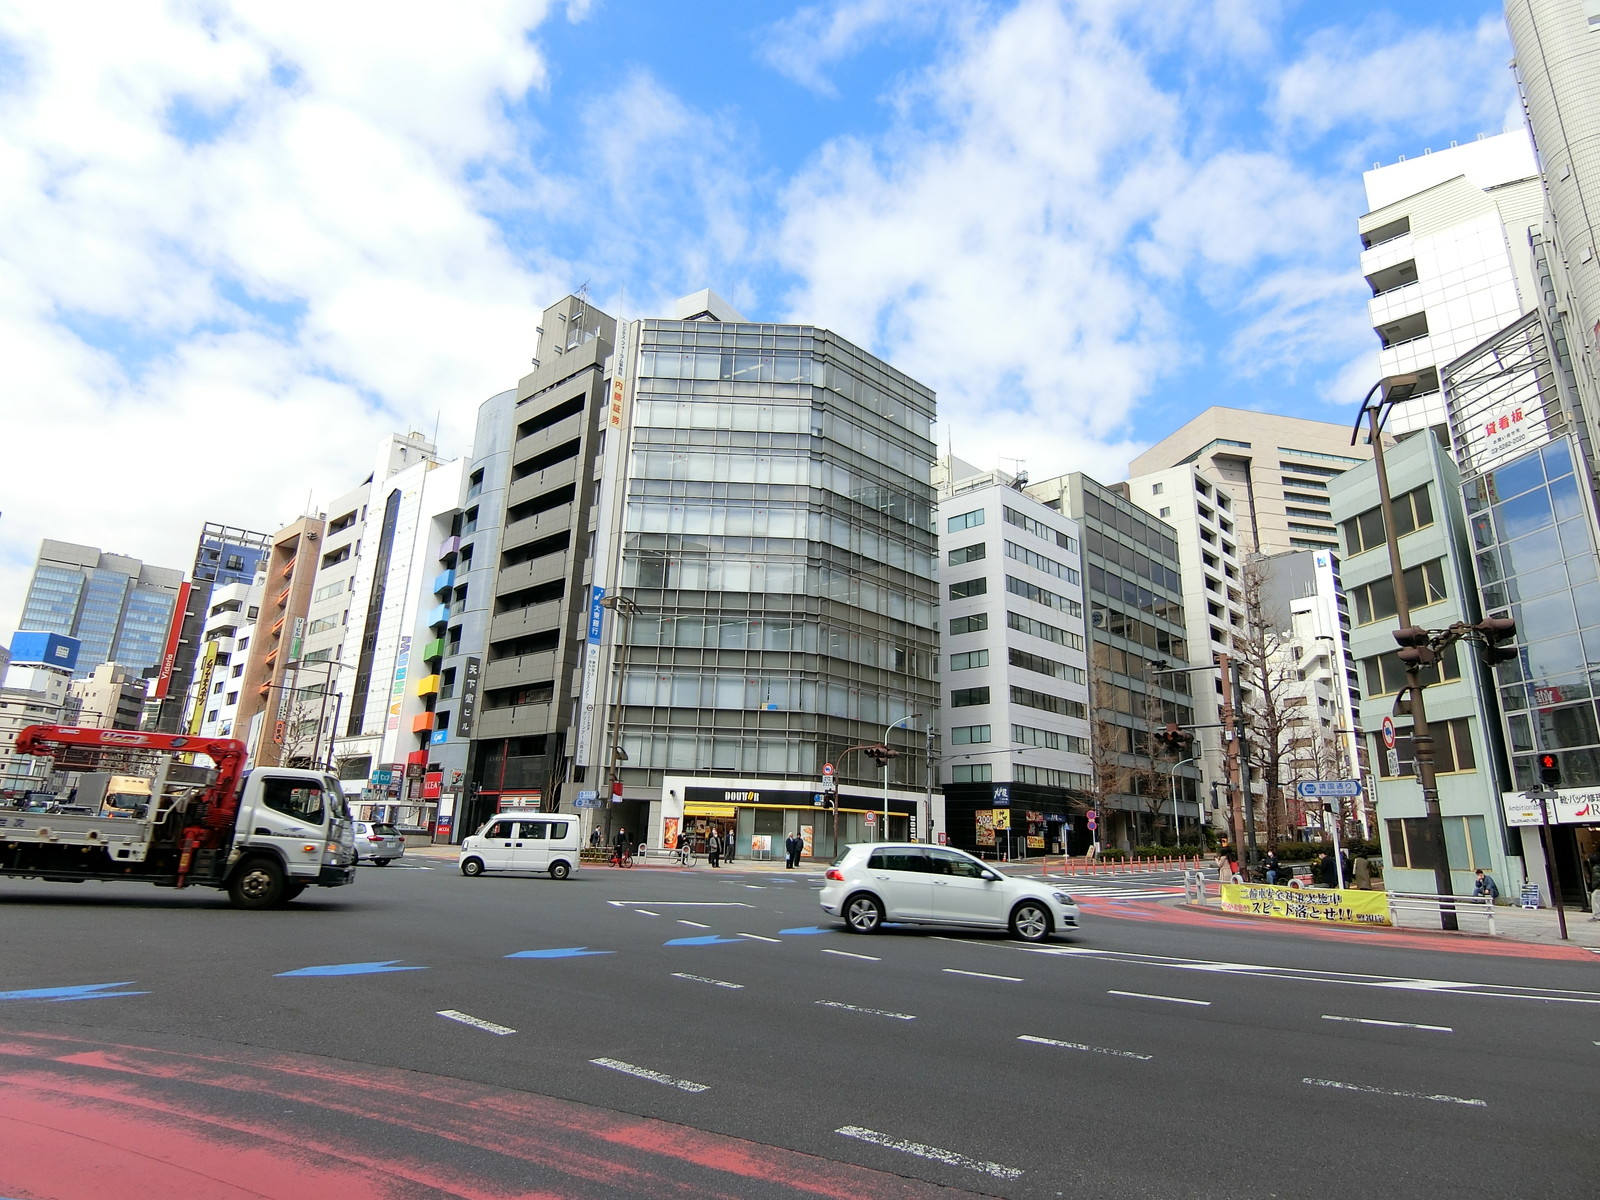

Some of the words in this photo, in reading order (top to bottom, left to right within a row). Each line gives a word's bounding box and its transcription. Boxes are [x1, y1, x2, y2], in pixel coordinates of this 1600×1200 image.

[1485, 407, 1524, 437] 貸看板
[161, 653, 173, 680] Victoria
[387, 635, 412, 730] RAINBOW
[724, 791, 760, 802] DOUTOR
